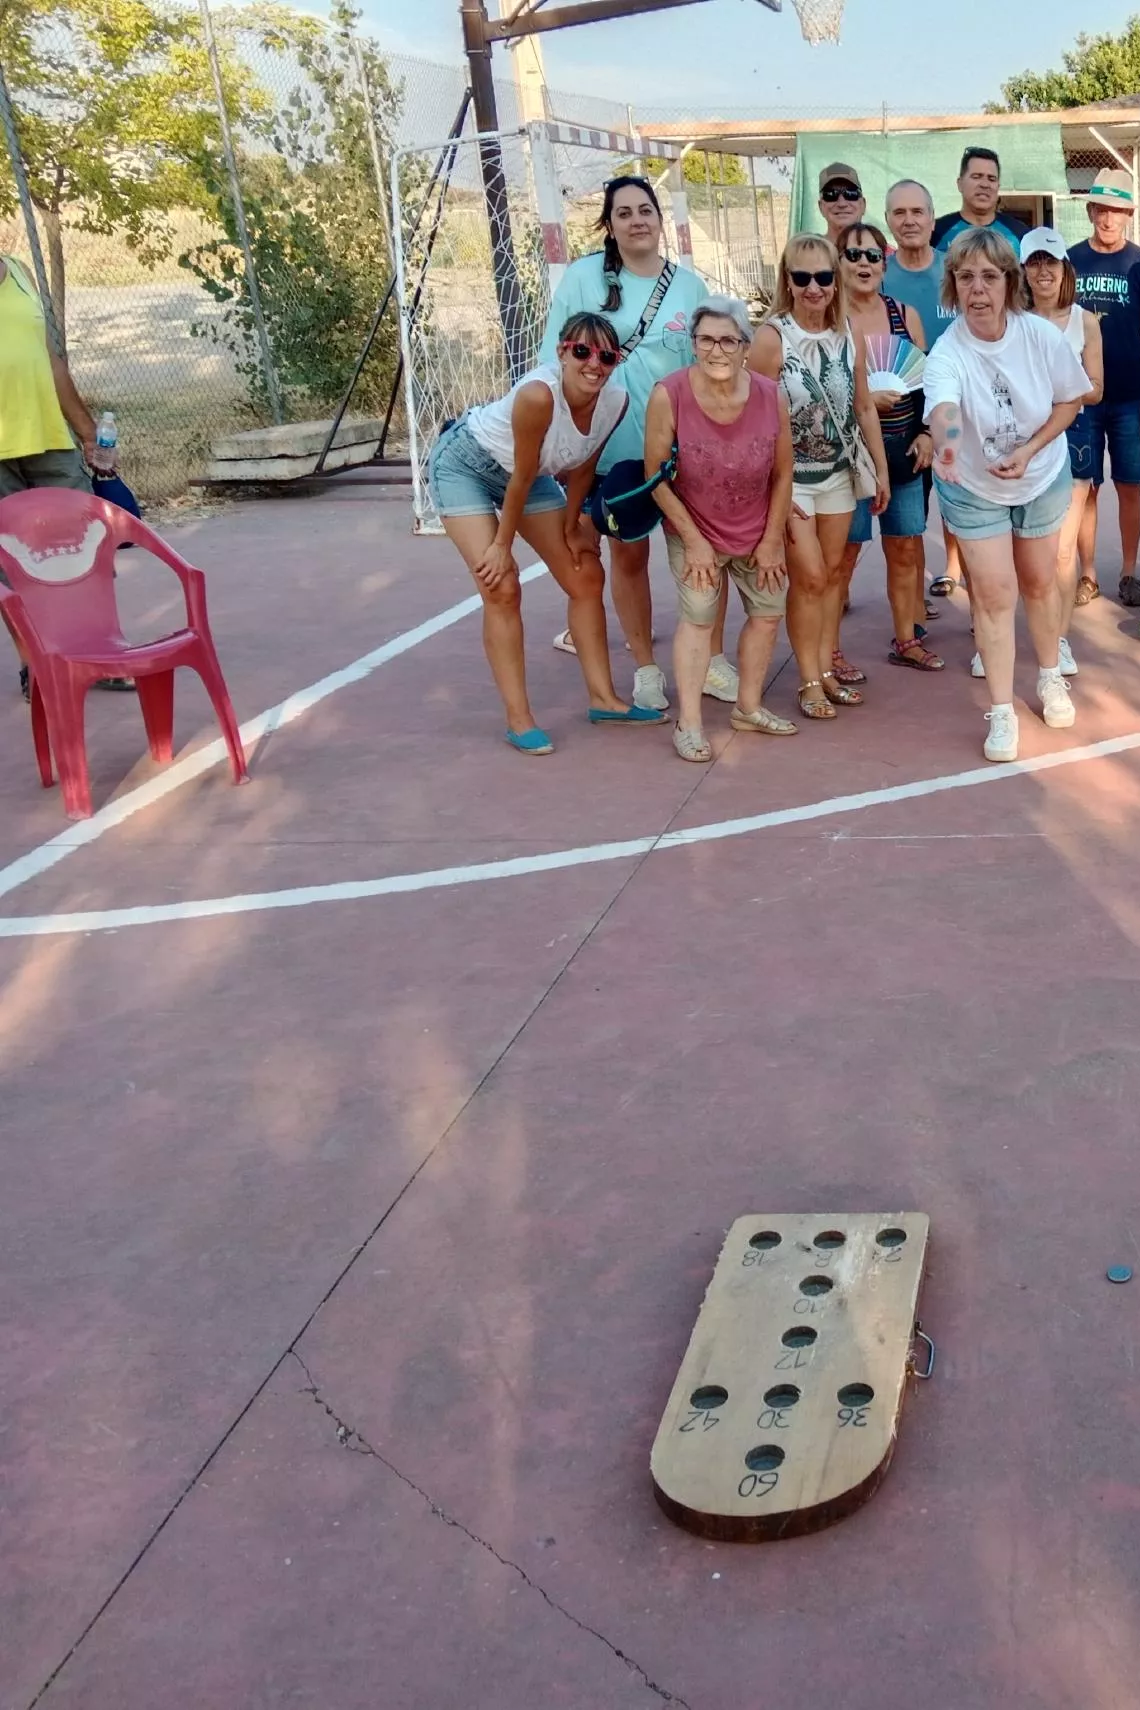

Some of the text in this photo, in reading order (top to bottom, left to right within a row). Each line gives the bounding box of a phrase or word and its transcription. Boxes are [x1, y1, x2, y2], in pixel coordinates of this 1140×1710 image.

[1075, 278, 1085, 293] EL
[1086, 276, 1128, 295] CUERNO
[741, 1251, 767, 1267] 18
[793, 1298, 817, 1314] 10
[773, 1350, 807, 1370] 12
[678, 1410, 720, 1433] 42
[756, 1408, 793, 1430] 30
[836, 1407, 872, 1428] 36
[737, 1472, 780, 1498] 60
